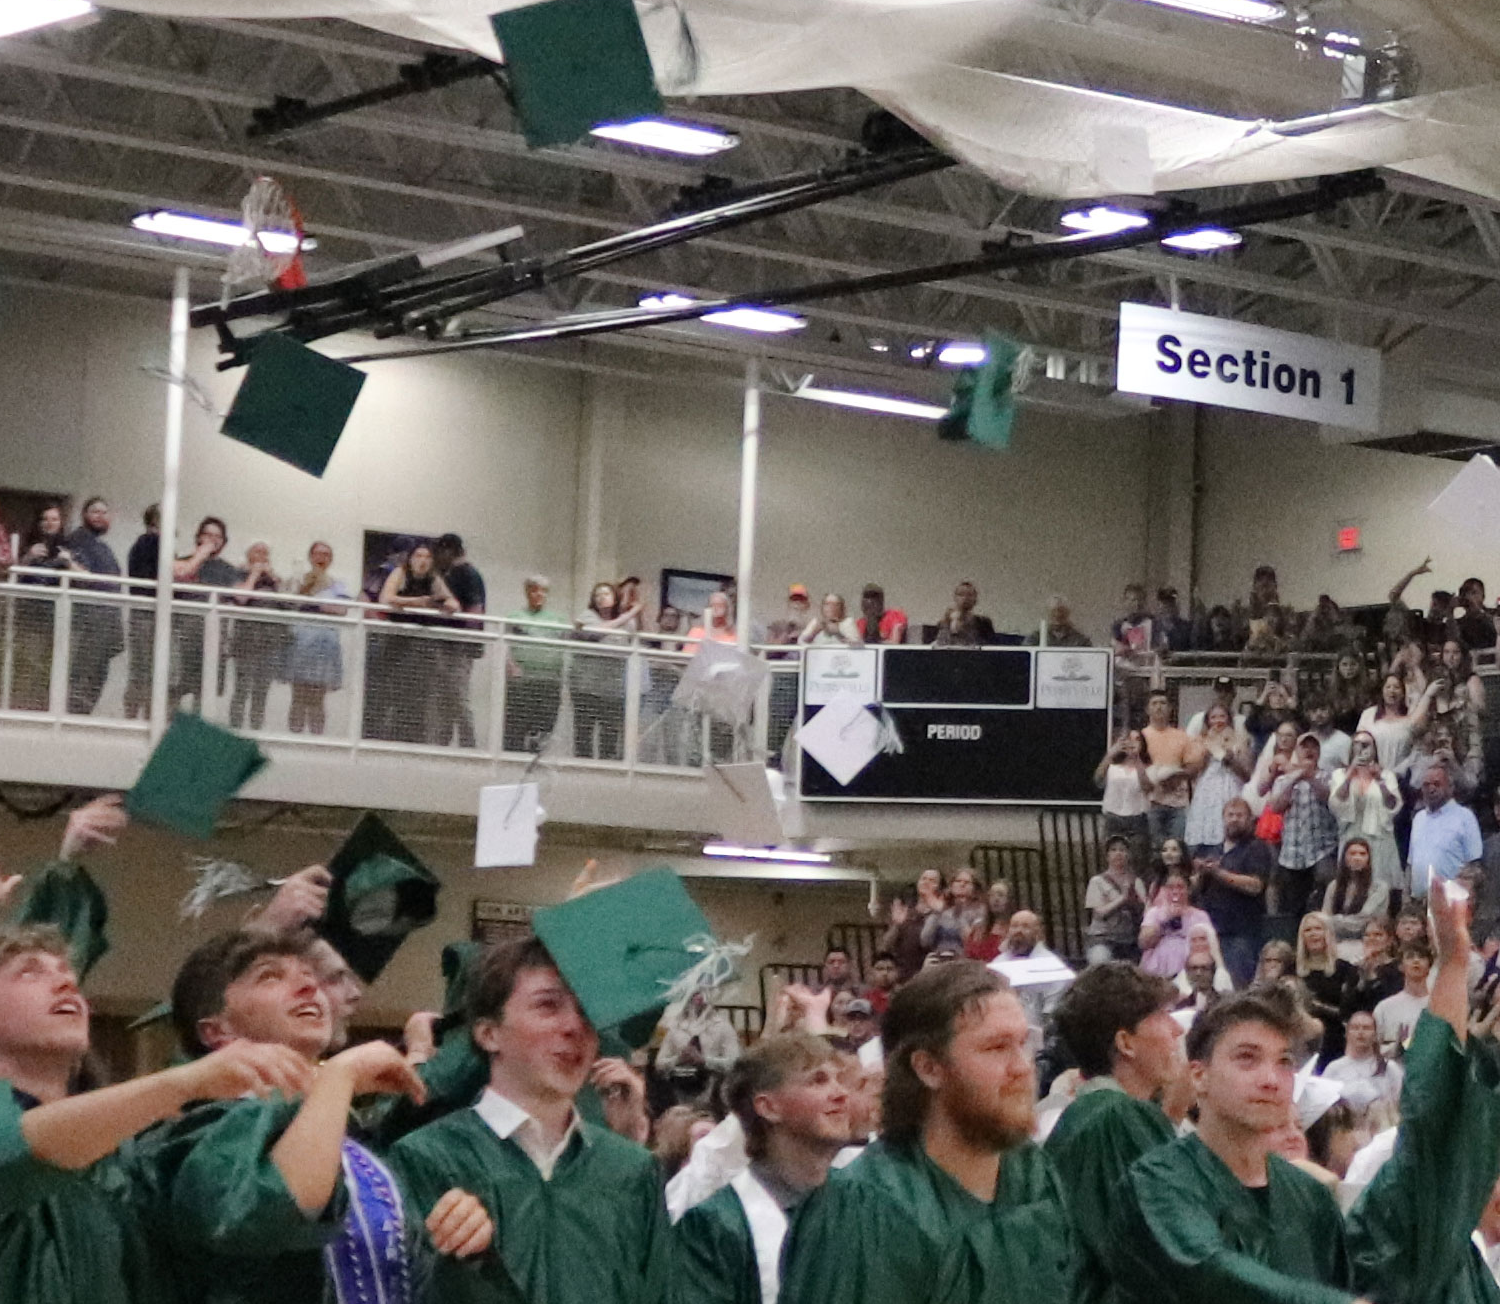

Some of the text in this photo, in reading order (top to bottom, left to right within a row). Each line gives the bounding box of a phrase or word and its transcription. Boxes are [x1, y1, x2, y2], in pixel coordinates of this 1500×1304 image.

[1156, 335, 1356, 405] Section 1
[927, 724, 982, 740] PERIOD
